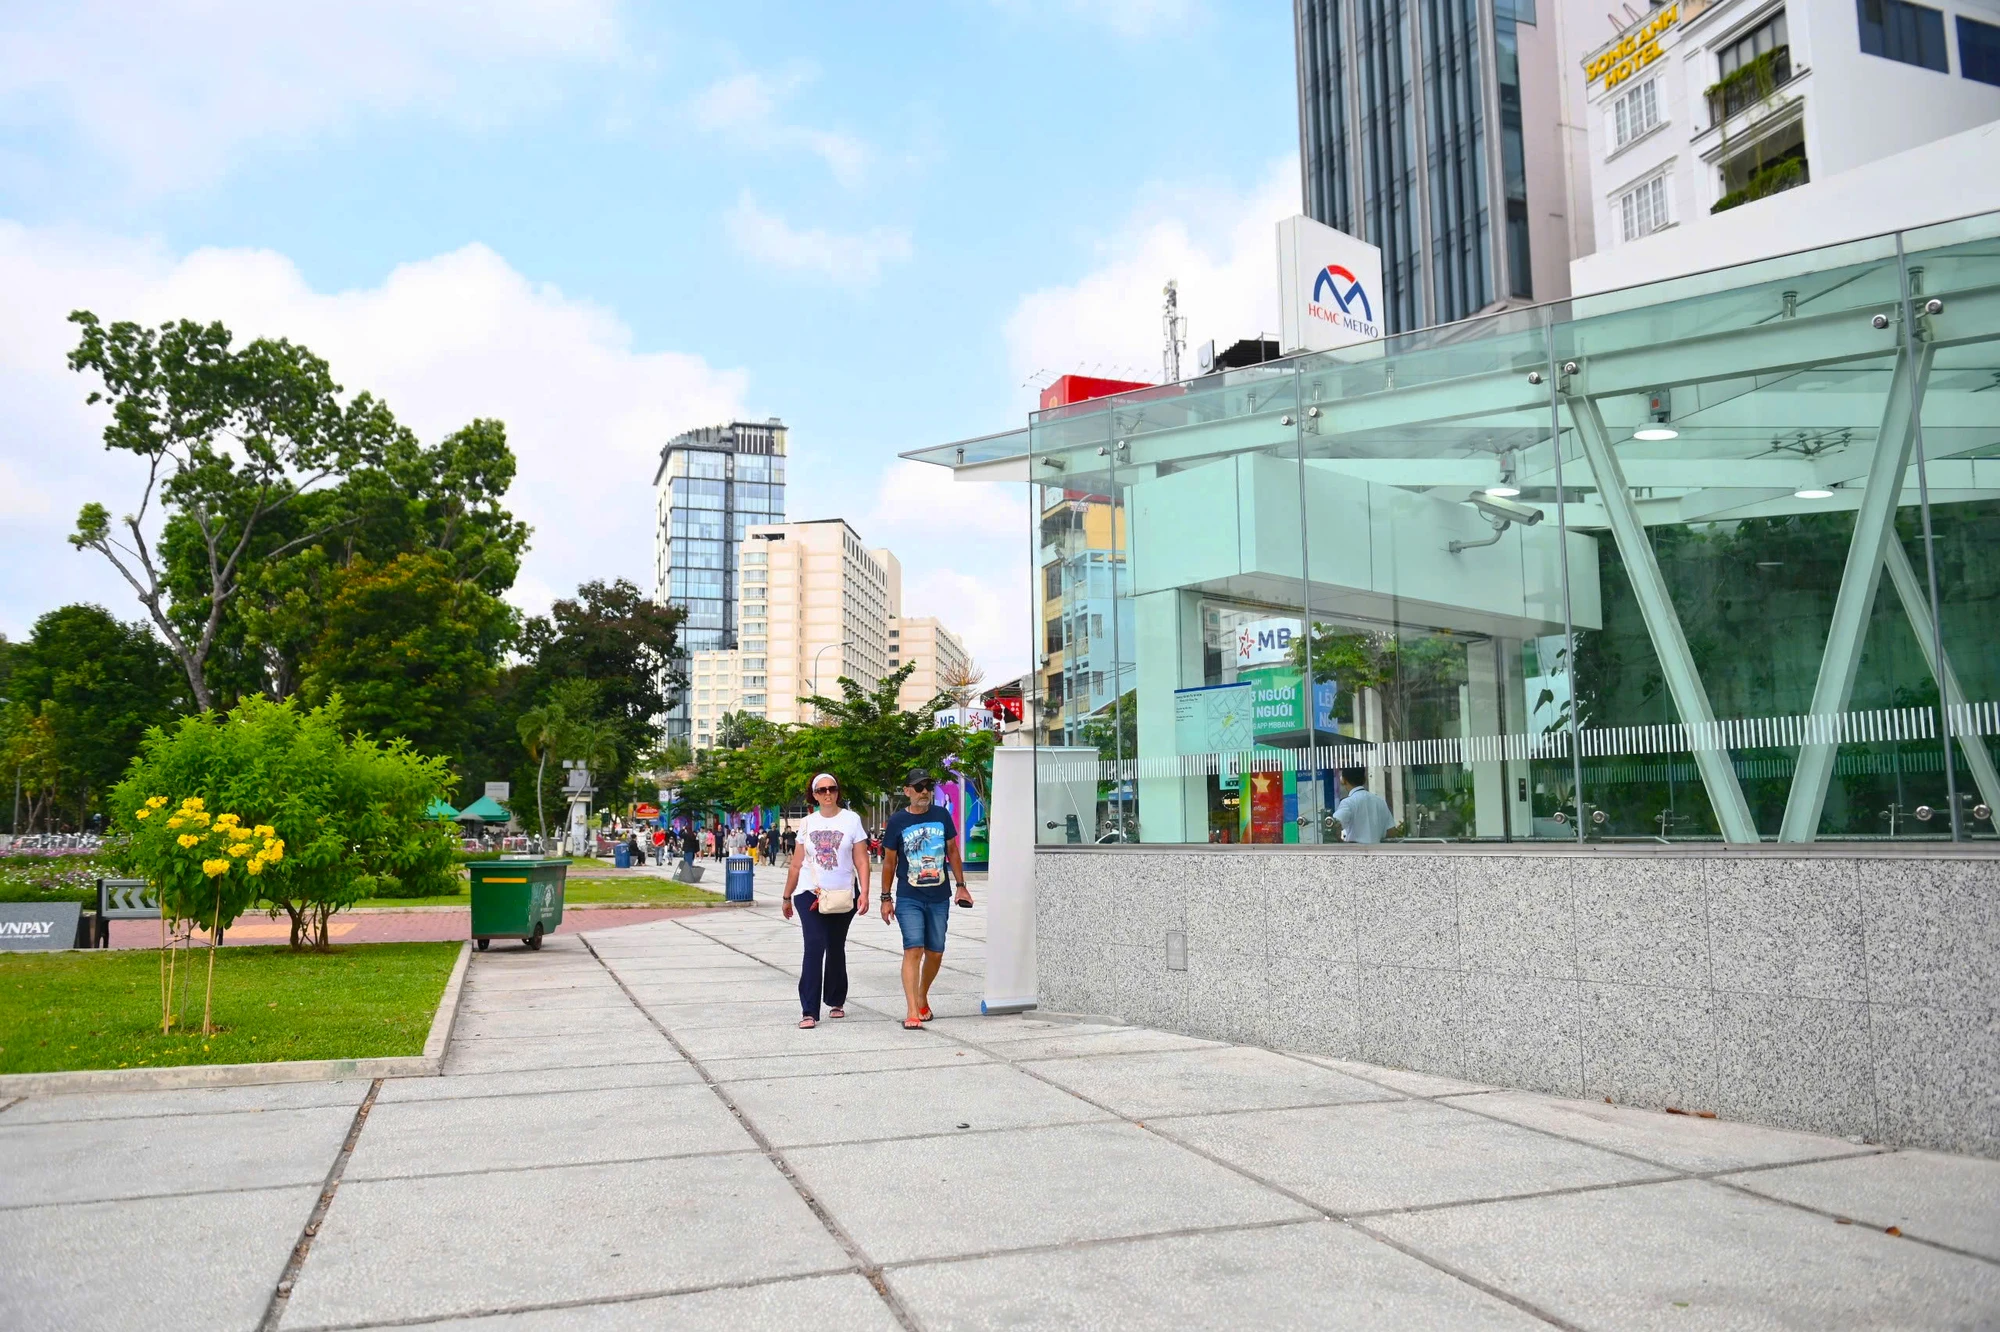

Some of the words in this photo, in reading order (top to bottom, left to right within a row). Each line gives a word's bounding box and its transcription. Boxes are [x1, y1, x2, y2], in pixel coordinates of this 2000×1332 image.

[1586, 36, 1637, 82] SONG
[1639, 4, 1678, 48] ANH
[1604, 41, 1664, 90] HOTEL
[1308, 303, 1340, 325] HCMC
[1343, 316, 1379, 339] METRO
[1258, 627, 1292, 651] MB
[1258, 686, 1296, 702] NGƯỜI
[1256, 702, 1293, 718] NGƯỜI
[940, 715, 956, 728] MB
[1268, 721, 1296, 729] MBBANK
[904, 827, 924, 843] SURF
[926, 827, 944, 837] TRIP
[0, 921, 54, 934] VNPAY
